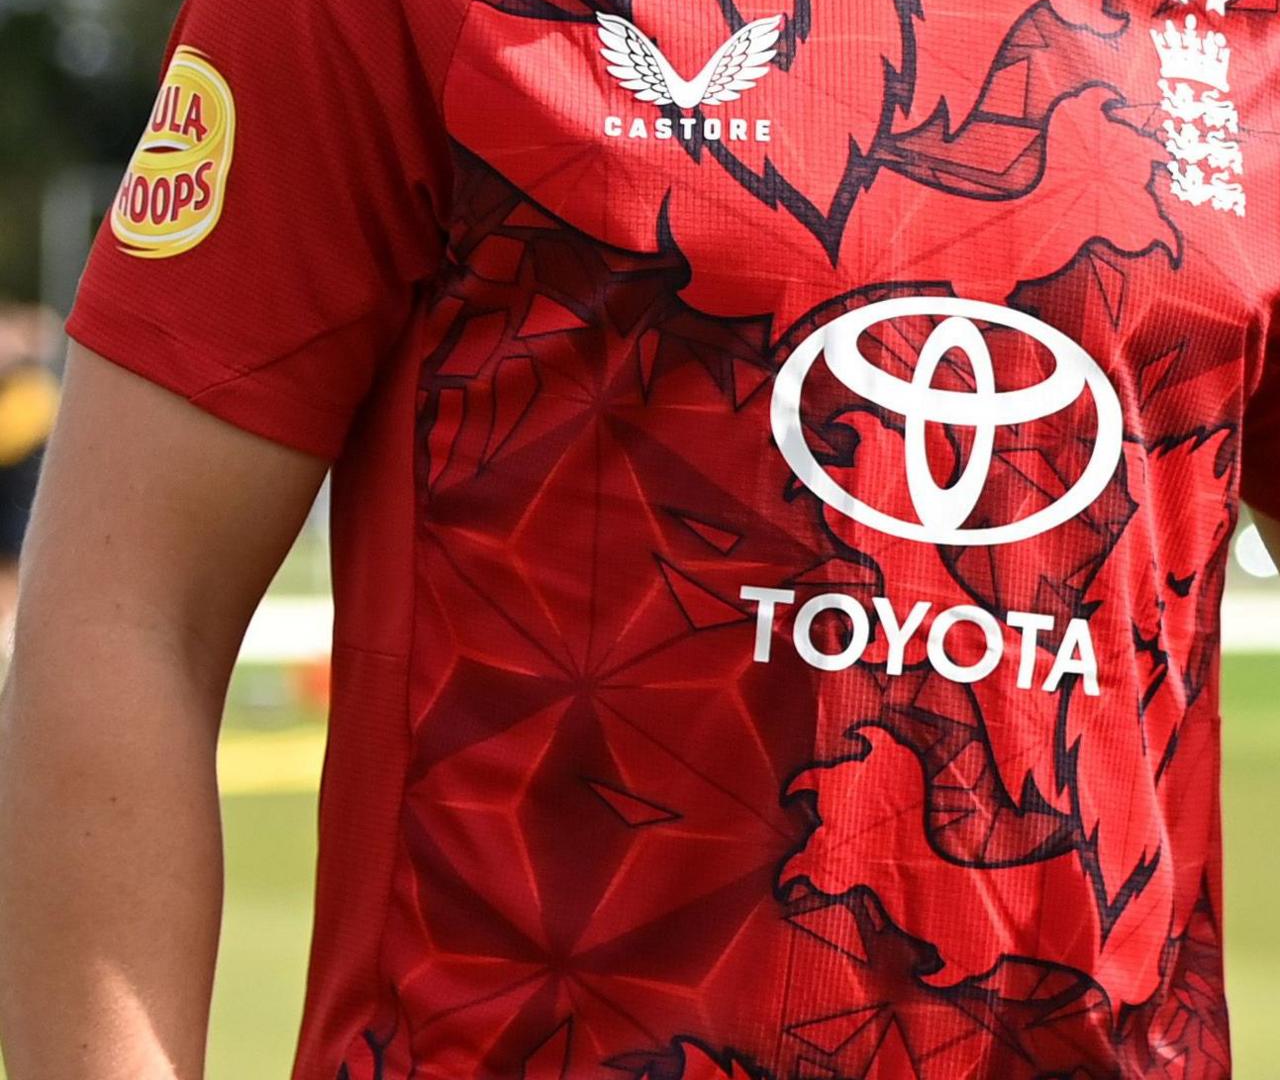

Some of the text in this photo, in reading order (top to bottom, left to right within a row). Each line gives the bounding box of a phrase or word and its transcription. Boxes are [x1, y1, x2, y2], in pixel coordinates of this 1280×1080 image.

[152, 87, 207, 142] ULA
[604, 116, 771, 142] CASTORE
[739, 585, 1100, 696] TOYOTA
